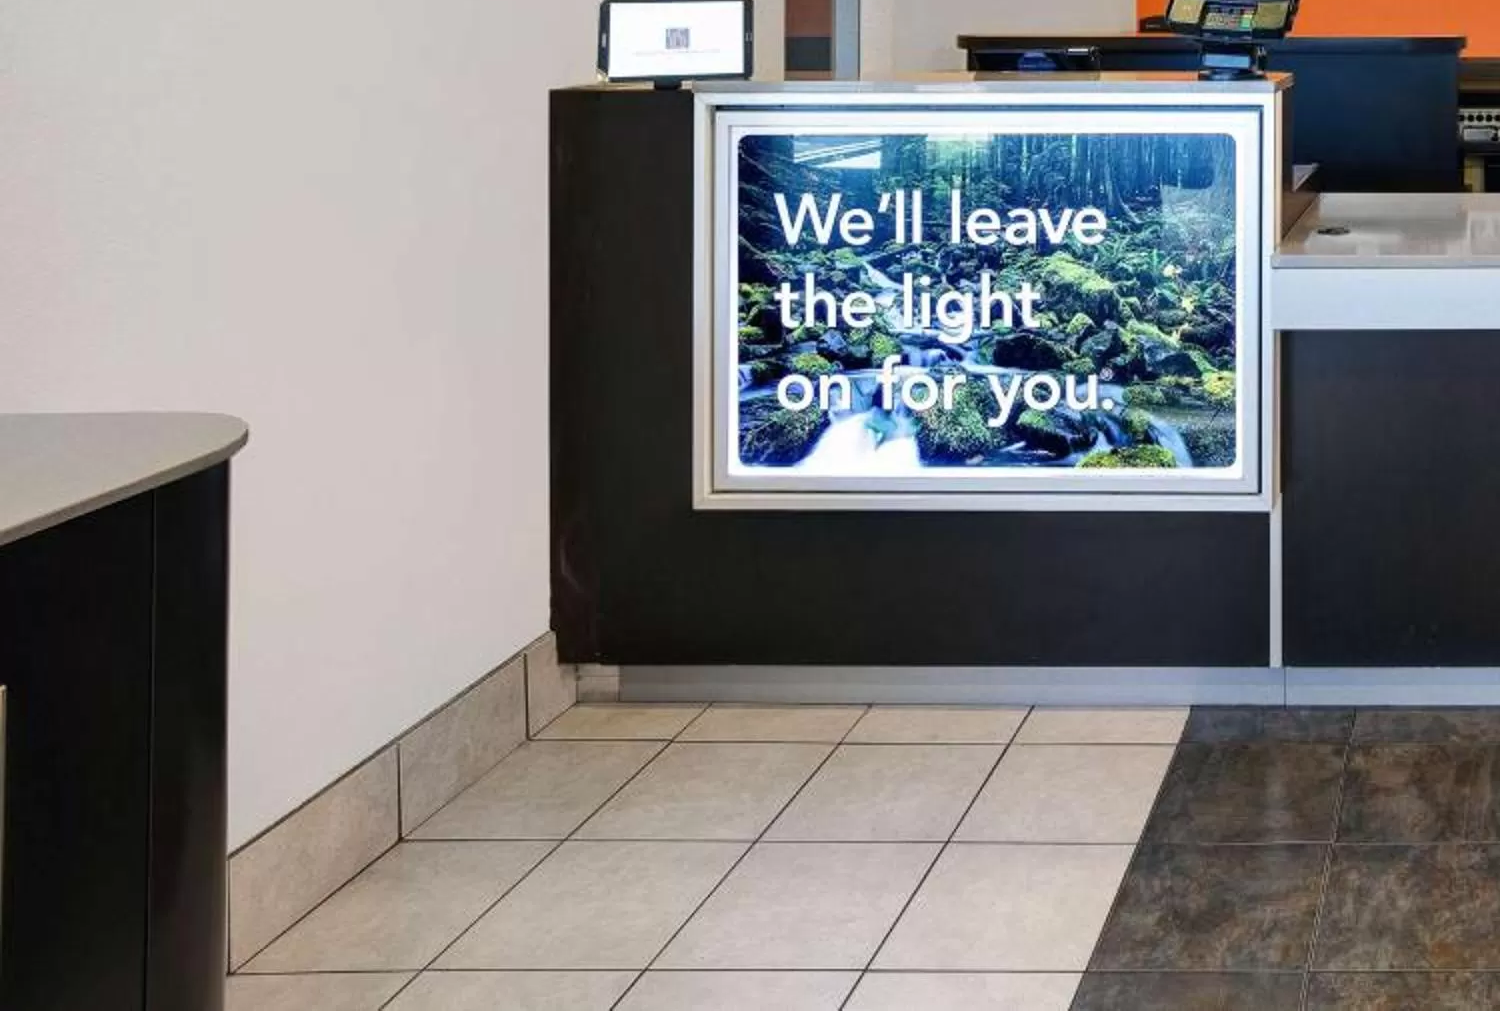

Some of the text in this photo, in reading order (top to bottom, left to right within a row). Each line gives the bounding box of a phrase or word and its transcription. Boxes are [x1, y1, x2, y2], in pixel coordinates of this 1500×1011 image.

[950, 189, 1107, 246] leave
[775, 273, 1042, 343] the light
[777, 354, 1115, 427] on for you.
